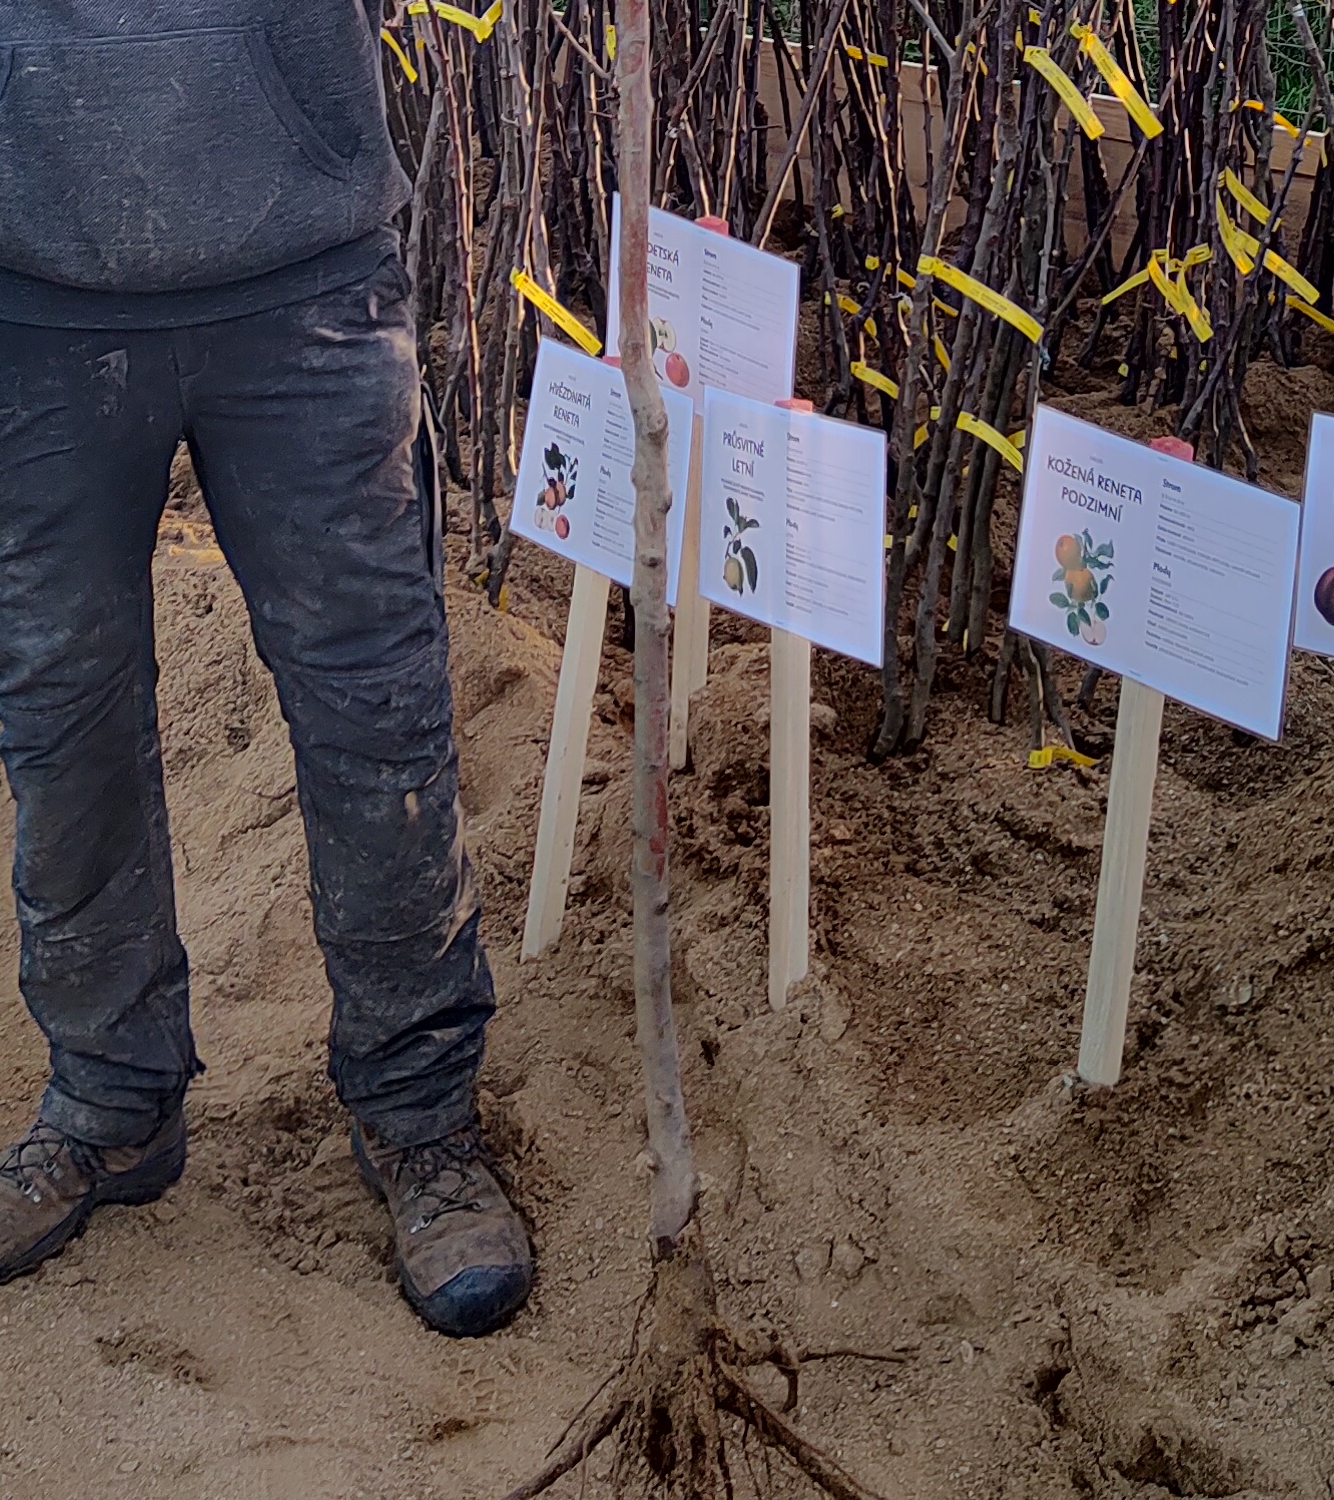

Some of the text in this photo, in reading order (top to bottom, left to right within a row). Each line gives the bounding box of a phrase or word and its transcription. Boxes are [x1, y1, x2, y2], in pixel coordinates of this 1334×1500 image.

[646, 261, 673, 283] ENETA
[549, 381, 591, 411] HVĚZDNATÁ
[553, 405, 580, 428] RENETA
[722, 430, 764, 458] PRŮSVITNÉ
[732, 457, 755, 478] LETNÍ
[1047, 454, 1142, 505] KOŽENÁ RENETA
[1061, 486, 1124, 523] PODZIMNÍ
